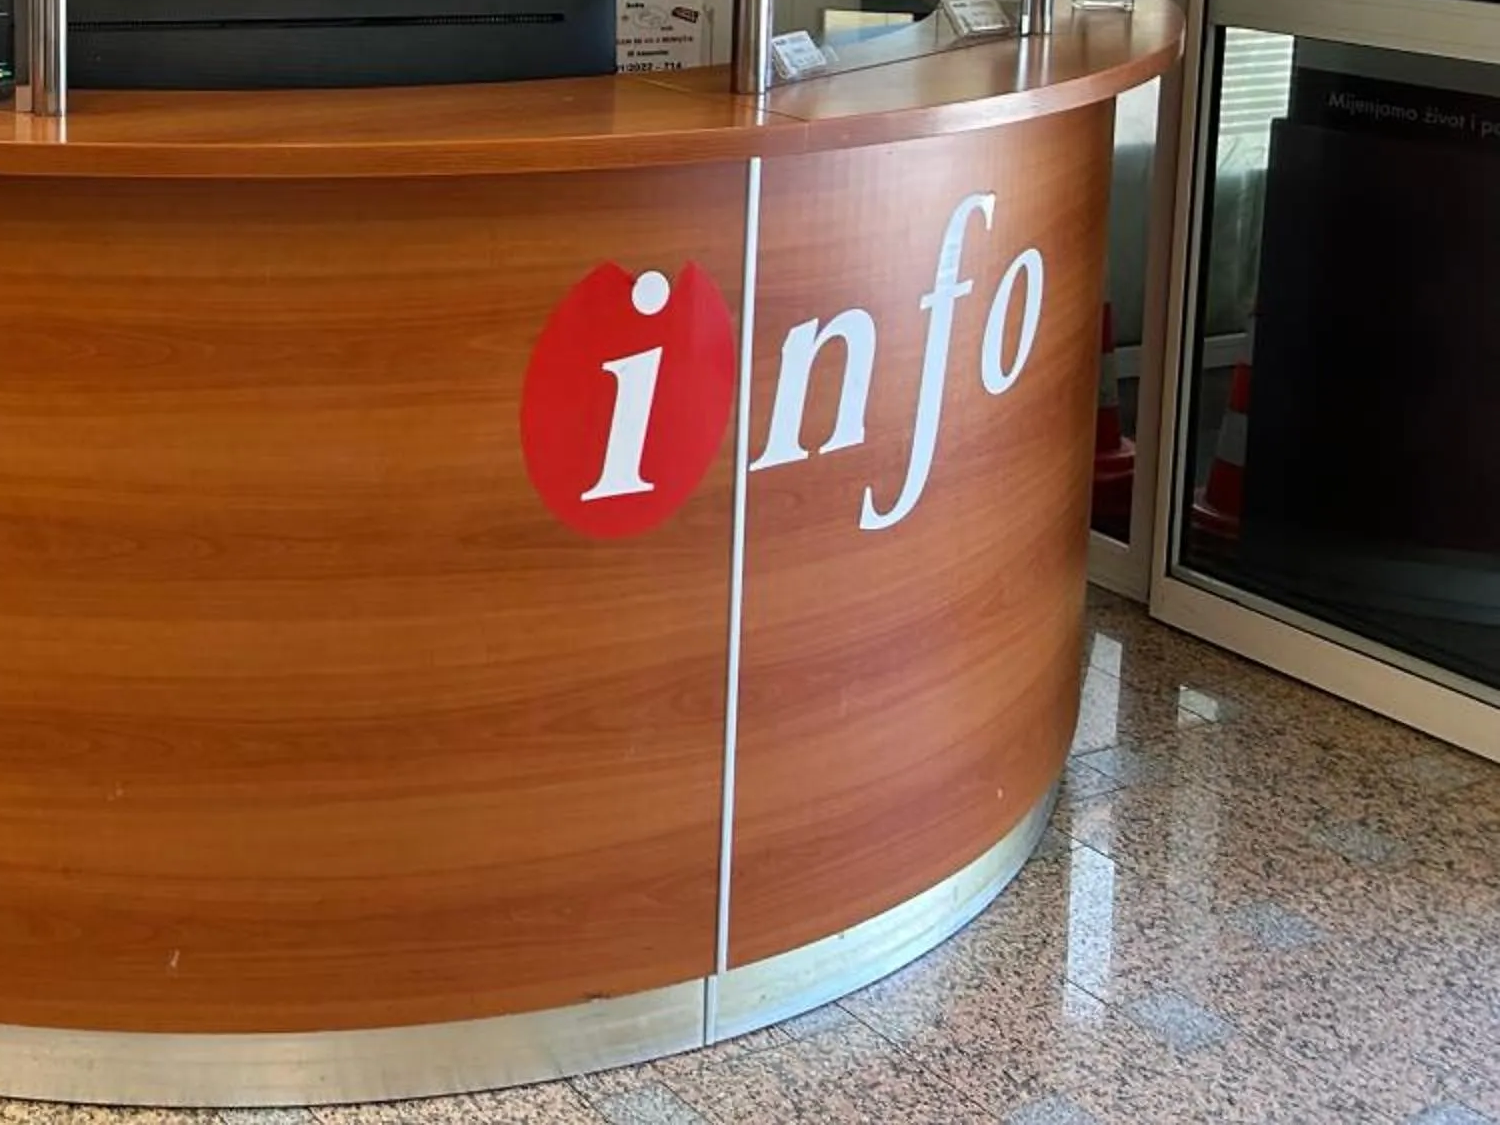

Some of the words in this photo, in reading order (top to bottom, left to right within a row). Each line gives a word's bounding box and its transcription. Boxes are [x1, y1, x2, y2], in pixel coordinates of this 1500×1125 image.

[1328, 90, 1418, 121] Mijenjamo
[1422, 105, 1466, 130] život
[581, 192, 1044, 530] info
